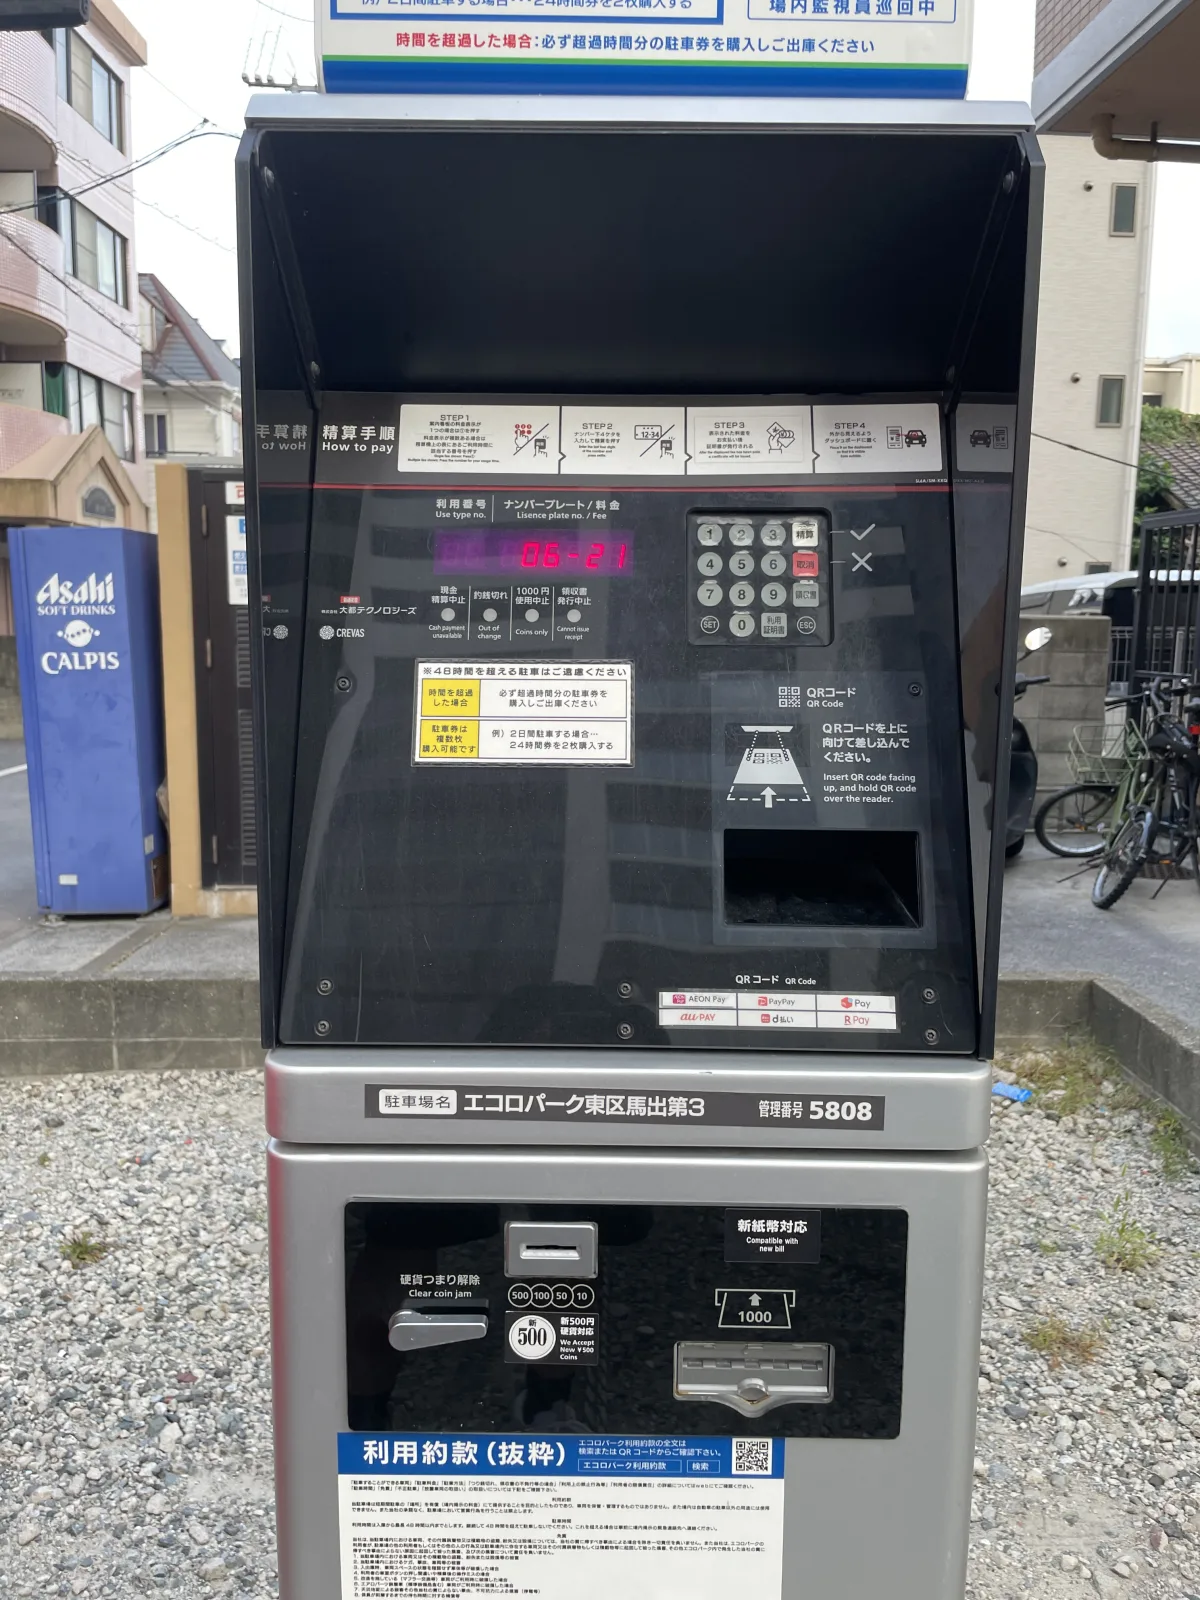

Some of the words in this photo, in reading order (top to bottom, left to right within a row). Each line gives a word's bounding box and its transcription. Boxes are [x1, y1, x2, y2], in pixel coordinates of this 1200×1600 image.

[769, 0, 936, 16] 場内監視員巡回中
[322, 425, 397, 442] 精算手順
[322, 442, 350, 452] How
[354, 443, 367, 453] to
[371, 445, 394, 455] pay
[436, 498, 487, 509] 利用番号
[435, 511, 452, 519] Use
[453, 511, 472, 521] type
[517, 511, 548, 519] Lisence
[549, 512, 570, 521] plate
[592, 512, 607, 520] Fee
[706, 528, 713, 540] 1
[737, 529, 746, 541] 2
[769, 529, 777, 540] 3
[796, 530, 815, 540] 精算
[706, 559, 714, 570] 4
[738, 559, 746, 570] 5
[769, 559, 778, 570] 6
[796, 559, 815, 569] 取消
[36, 572, 114, 605] Asahi
[440, 585, 458, 595] 現金
[561, 587, 588, 596] 領収書
[473, 590, 508, 600] 釣銭切れ
[706, 589, 714, 600] 7
[738, 589, 746, 600] 8
[769, 589, 778, 600] 9
[431, 595, 466, 605] 精算中止
[515, 596, 550, 605] 使用中止
[557, 596, 592, 606] 発行中止
[37, 604, 69, 616] SOFT
[71, 604, 116, 616] DRINKS
[339, 606, 417, 616] 大都テクノロジーズ
[703, 620, 717, 629] SET
[738, 620, 746, 631] 0
[766, 616, 782, 625] 利用
[799, 621, 814, 629] ESC
[336, 628, 365, 638] CREVAS
[428, 624, 442, 632] Cash
[442, 624, 466, 633] payment
[491, 624, 500, 632] of
[515, 628, 533, 636] Coins
[533, 628, 549, 637] only
[556, 625, 576, 633] Cannot
[576, 625, 590, 633] issue
[763, 625, 785, 635] 証明書
[477, 632, 502, 640] change
[564, 633, 584, 641] receipt
[41, 651, 120, 675] CALPIS
[423, 666, 627, 678] ※48時間を超える駐車はご遠慮ください
[428, 688, 474, 697] 時間を超過
[498, 688, 608, 699] 必ず超過時間分の駐車券を
[806, 686, 856, 699] QRコード
[433, 698, 468, 707] した場合
[508, 698, 598, 709] 購入しご出庫ください
[806, 700, 820, 708] QR
[821, 699, 844, 708] Code
[431, 724, 468, 734] 駐車券は
[822, 722, 908, 735] QRコードを上に
[435, 734, 463, 744] 複数枚
[822, 737, 910, 749] 向けて差し込んで
[422, 744, 477, 754] 購入可能です
[509, 741, 614, 751] 24時間券を2枚購入する
[823, 751, 872, 763] ください。
[823, 772, 849, 781] Insert
[850, 773, 864, 782] QR
[865, 773, 887, 782] code
[888, 773, 916, 784] facing
[823, 785, 838, 794] up,
[839, 784, 857, 792] and
[858, 784, 878, 793] hold
[880, 785, 894, 793] QR
[895, 785, 917, 793] code
[823, 795, 843, 803] over
[846, 795, 861, 803] the
[862, 795, 894, 803] reader.
[785, 978, 797, 986] QR
[798, 977, 817, 986] Code
[688, 995, 711, 1003] AEON
[712, 994, 727, 1005] Pay
[768, 997, 796, 1008] PayPay
[854, 999, 871, 1010] Pay
[680, 1012, 699, 1021] au
[699, 1013, 716, 1022] PAY
[772, 1013, 794, 1024] d払い
[853, 1015, 871, 1026] Pay
[384, 1094, 451, 1110] 駐車場名
[463, 1094, 706, 1118] エコロパーク東区馬出第3
[758, 1099, 804, 1120] 管理番号
[808, 1100, 873, 1121] 5808
[737, 1218, 808, 1234] 新紙幣対応
[746, 1236, 783, 1246] Compatible
[785, 1237, 799, 1245] with
[774, 1245, 785, 1253] bill
[400, 1273, 481, 1286] 硬貨つまり解除
[409, 1289, 432, 1298] Clear
[434, 1289, 453, 1298] coin
[454, 1290, 472, 1300] jam
[512, 1291, 529, 1300] 500
[534, 1291, 550, 1300] 100
[556, 1291, 568, 1300] 50
[576, 1292, 587, 1301] 10
[528, 1317, 537, 1327] 新
[560, 1316, 595, 1326] 新500円
[737, 1310, 772, 1324] 1000
[560, 1326, 595, 1336] 硬貨対応
[517, 1327, 547, 1347] 500
[572, 1339, 595, 1348] Accept
[559, 1353, 578, 1361] Coins
[578, 1439, 687, 1448] エコロパーク利用約款の全文は
[583, 1461, 667, 1471] エコロパーク利用約款
[691, 1461, 709, 1472] 検索
